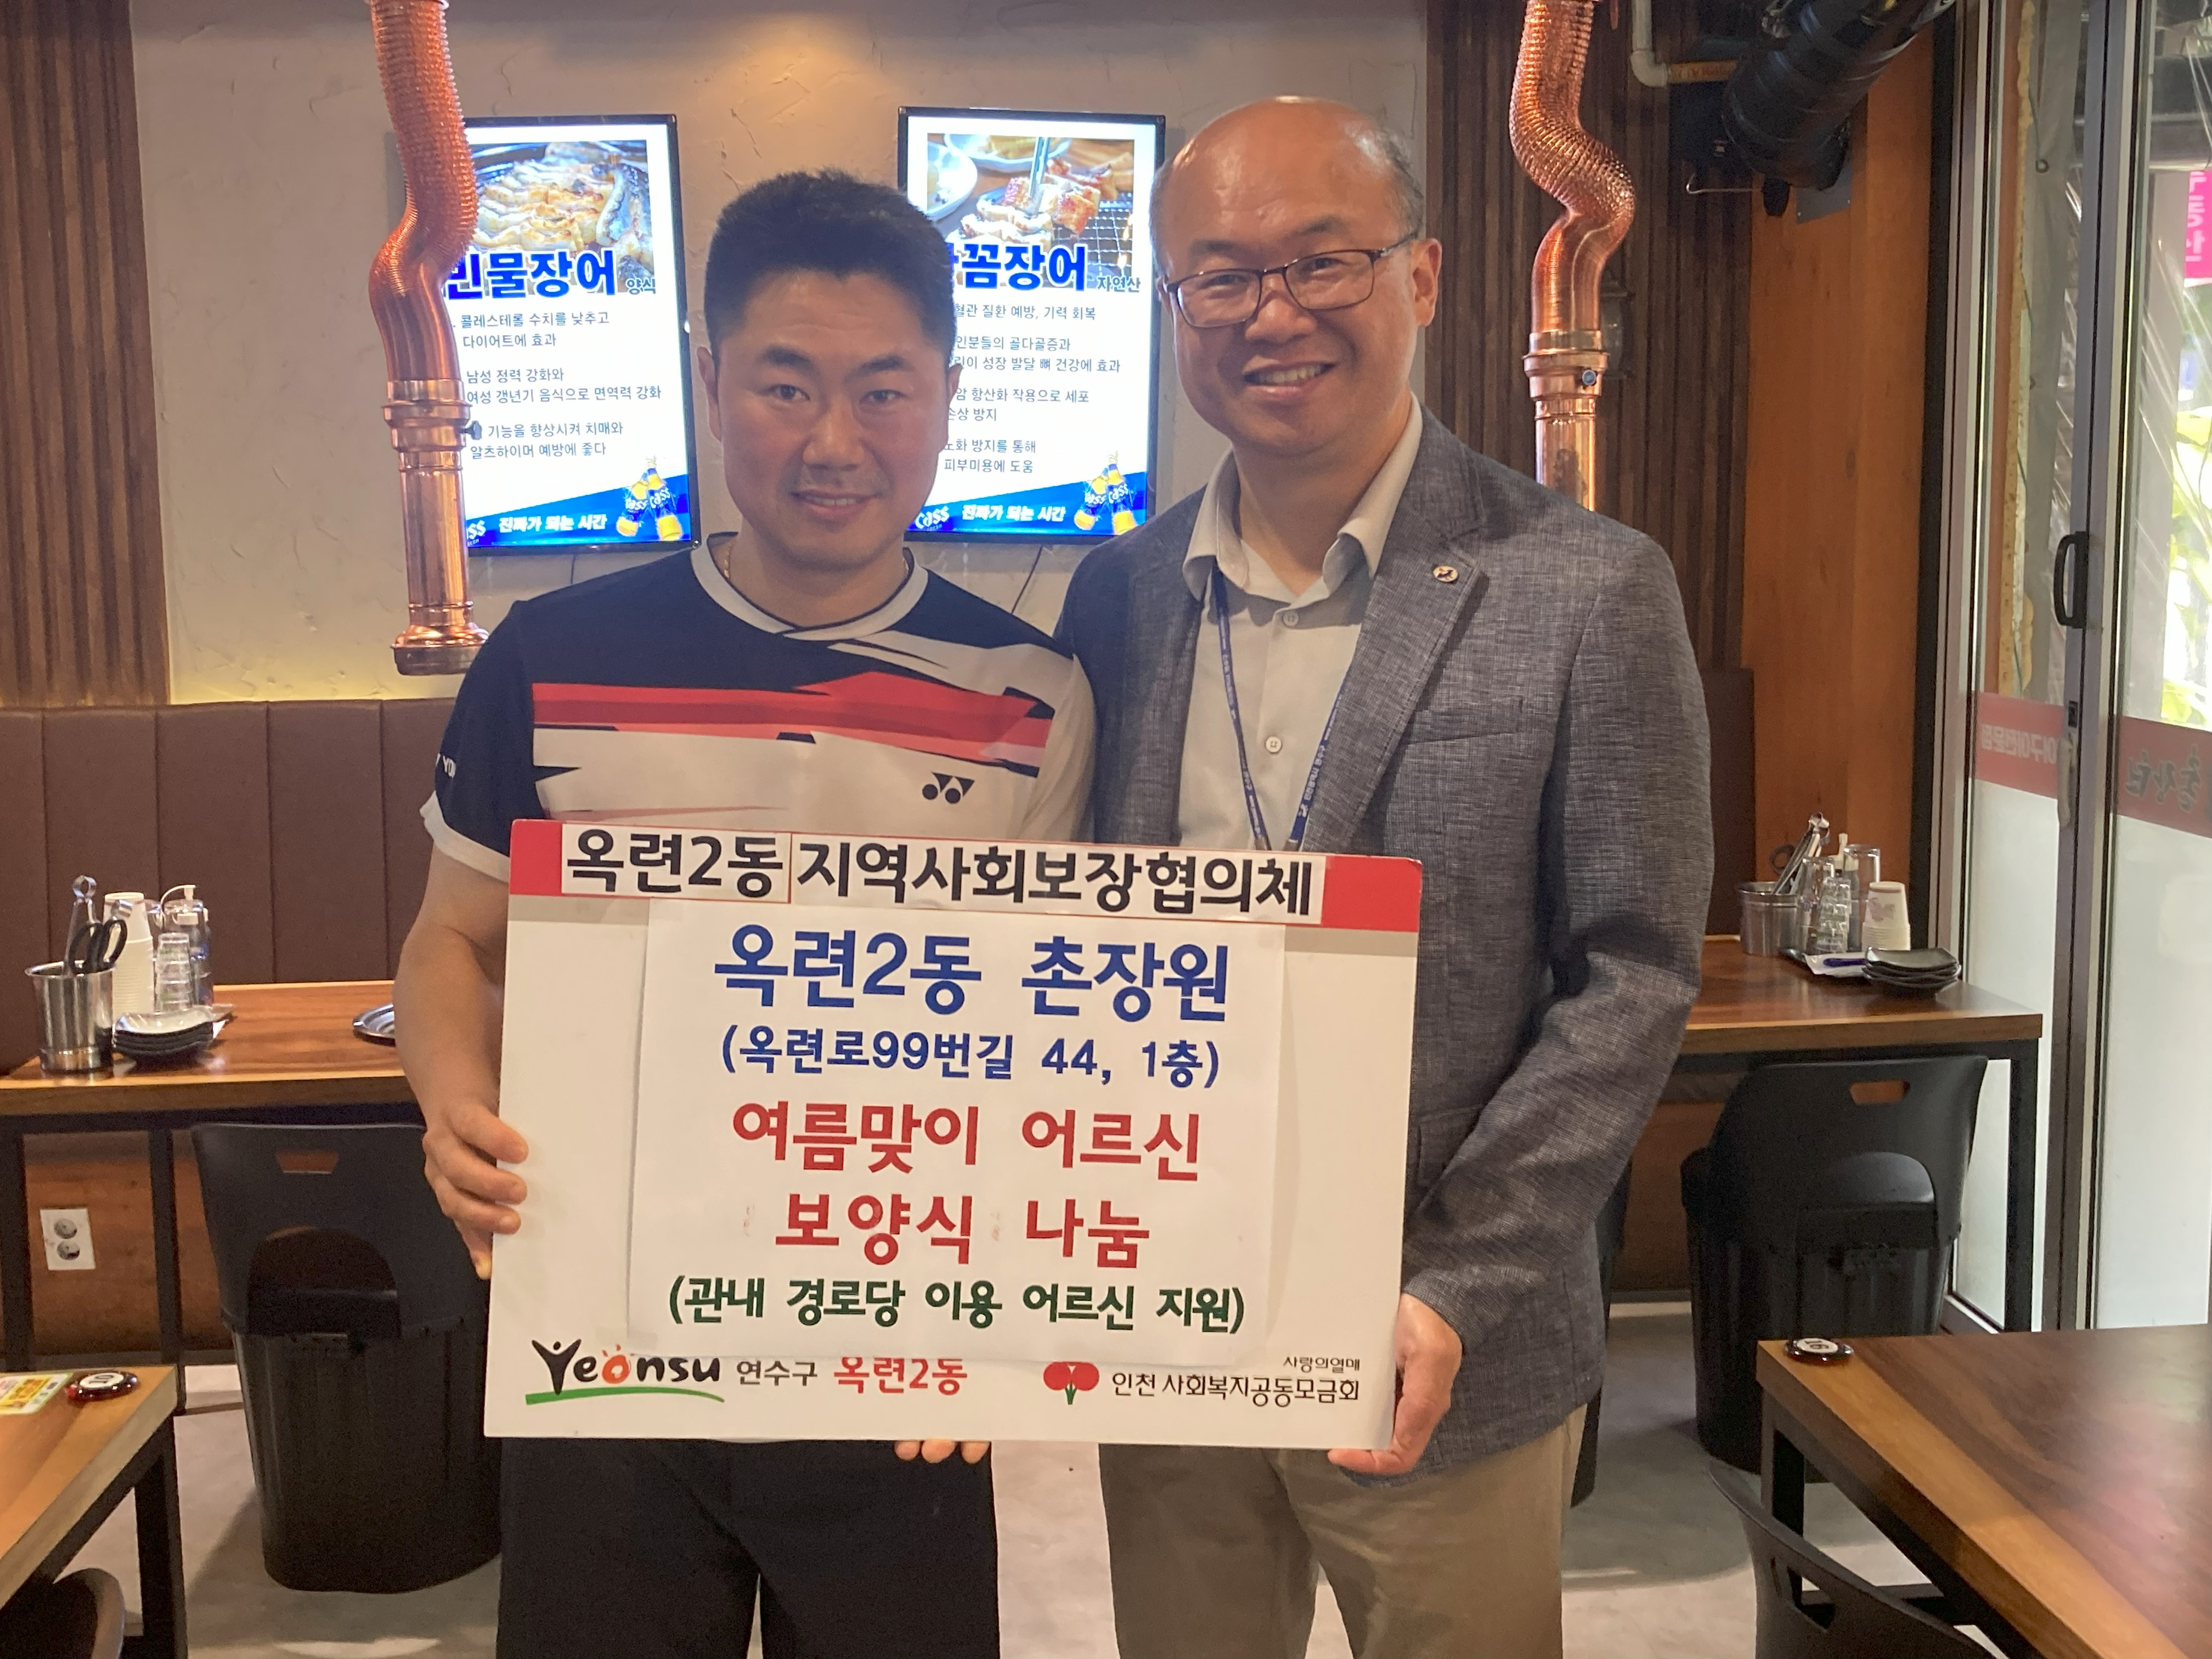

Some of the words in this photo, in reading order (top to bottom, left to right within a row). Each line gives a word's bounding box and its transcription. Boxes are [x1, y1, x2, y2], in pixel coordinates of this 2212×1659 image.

[448, 250, 616, 300] 민물장어
[946, 243, 1087, 291] 꼼장어
[626, 277, 656, 295] 양식
[1097, 276, 1141, 293] 자연산
[461, 313, 524, 329] 콜레스테롤
[529, 312, 567, 326] 수치를
[571, 311, 610, 325] 낮추고
[955, 303, 978, 318] 혈관
[982, 304, 1007, 318] 질환
[1011, 305, 1039, 320] 예방,
[1043, 306, 1067, 320] 기력
[1073, 307, 1096, 320] 회복
[462, 334, 527, 349] 다이어트에
[532, 333, 557, 346] 효과
[957, 335, 1004, 350] 인분들의
[1009, 337, 1071, 352] 골다골증과
[983, 356, 1007, 370] 성장
[1011, 357, 1036, 371] 발달
[1040, 358, 1051, 371] 뼈
[1056, 358, 1092, 372] 건강에
[1096, 359, 1121, 373] 효과
[466, 370, 491, 384] 남성
[496, 369, 521, 383] 정력
[526, 368, 565, 382] 강화와
[467, 390, 491, 404] 여성
[496, 389, 534, 404] 갱년기
[539, 388, 590, 402] 음식으로
[594, 386, 631, 400] 면역력
[636, 385, 662, 400] 강화
[971, 387, 1008, 402] 항산화
[1012, 388, 1061, 403] 작용으로
[1065, 390, 1089, 403] 세포
[973, 408, 996, 421] 방지
[488, 424, 526, 438] 기능을
[530, 422, 580, 438] 향상시켜
[585, 421, 623, 436] 치매와
[470, 444, 534, 460] 알츠하이머
[539, 443, 577, 457] 예방에
[582, 442, 606, 456] 좋다
[972, 439, 1008, 453] 방지를
[1012, 439, 1036, 453] 통해
[944, 458, 1005, 473] 피부미용에
[1009, 460, 1033, 473] 도움
[578, 514, 607, 530] 시간
[1037, 506, 1066, 522] 시간
[567, 828, 783, 899] 옥련2동
[797, 842, 1314, 916] 지역사회보장협의체
[714, 924, 981, 1015] 옥련2동
[1022, 936, 1228, 1022] 촌장원
[723, 1025, 1013, 1080] (옥련로99번길
[1041, 1038, 1111, 1085] 44,
[1142, 1040, 1218, 1088] 1층)
[733, 1101, 979, 1174] 여름맞이
[1022, 1109, 1199, 1182] 어르신
[775, 1193, 973, 1266] 보양식
[1026, 1199, 1150, 1269] 나눔
[669, 1275, 765, 1324] (관내
[787, 1278, 906, 1328] 경로당
[925, 1280, 1003, 1329] 이용
[1023, 1283, 1135, 1331] 어르신
[1156, 1287, 1244, 1334] 지원)
[531, 1338, 720, 1396] Yeonsu
[1283, 1356, 1360, 1374] 사랑의열매
[736, 1360, 818, 1386] 연수구
[832, 1355, 969, 1396] 옥련2동
[1112, 1373, 1155, 1397] 인천
[1162, 1374, 1359, 1408] 사회복지공동모금회
